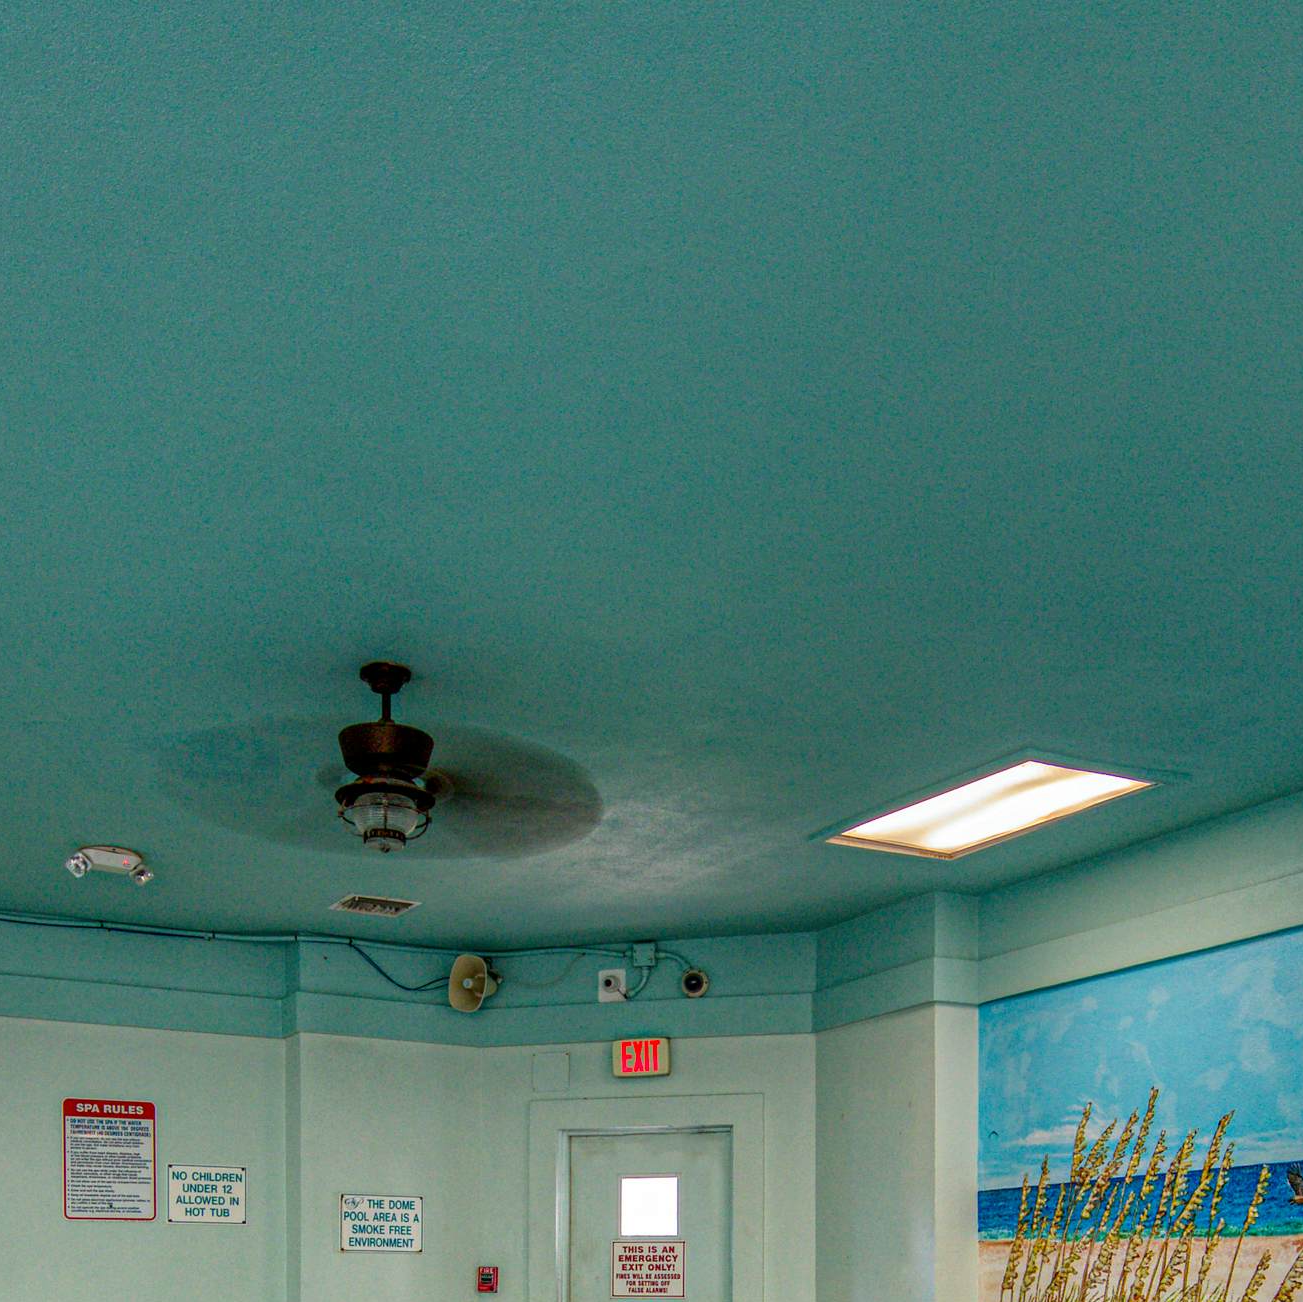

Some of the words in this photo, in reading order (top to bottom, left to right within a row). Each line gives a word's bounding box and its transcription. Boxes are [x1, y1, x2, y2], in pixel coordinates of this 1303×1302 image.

[621, 1040, 660, 1072] EXIT
[76, 1103, 100, 1112] SPA
[104, 1104, 144, 1114] RULES
[172, 1171, 187, 1180] NO
[192, 1172, 242, 1182] CHILDREN
[182, 1184, 218, 1193] UNDER
[222, 1185, 232, 1194] 12
[176, 1196, 225, 1205] ALLOWED
[230, 1197, 239, 1205] IN
[367, 1199, 384, 1209] THE
[389, 1200, 415, 1210] DOME
[185, 1208, 206, 1216] HOT
[210, 1208, 230, 1217] TUB
[344, 1211, 369, 1221] POOL
[373, 1212, 397, 1222] AREA
[401, 1214, 409, 1222] IS
[414, 1214, 419, 1223] A
[352, 1224, 385, 1234] SMOKE
[389, 1226, 412, 1235] FREE
[349, 1237, 414, 1248] ENVIRONMENT
